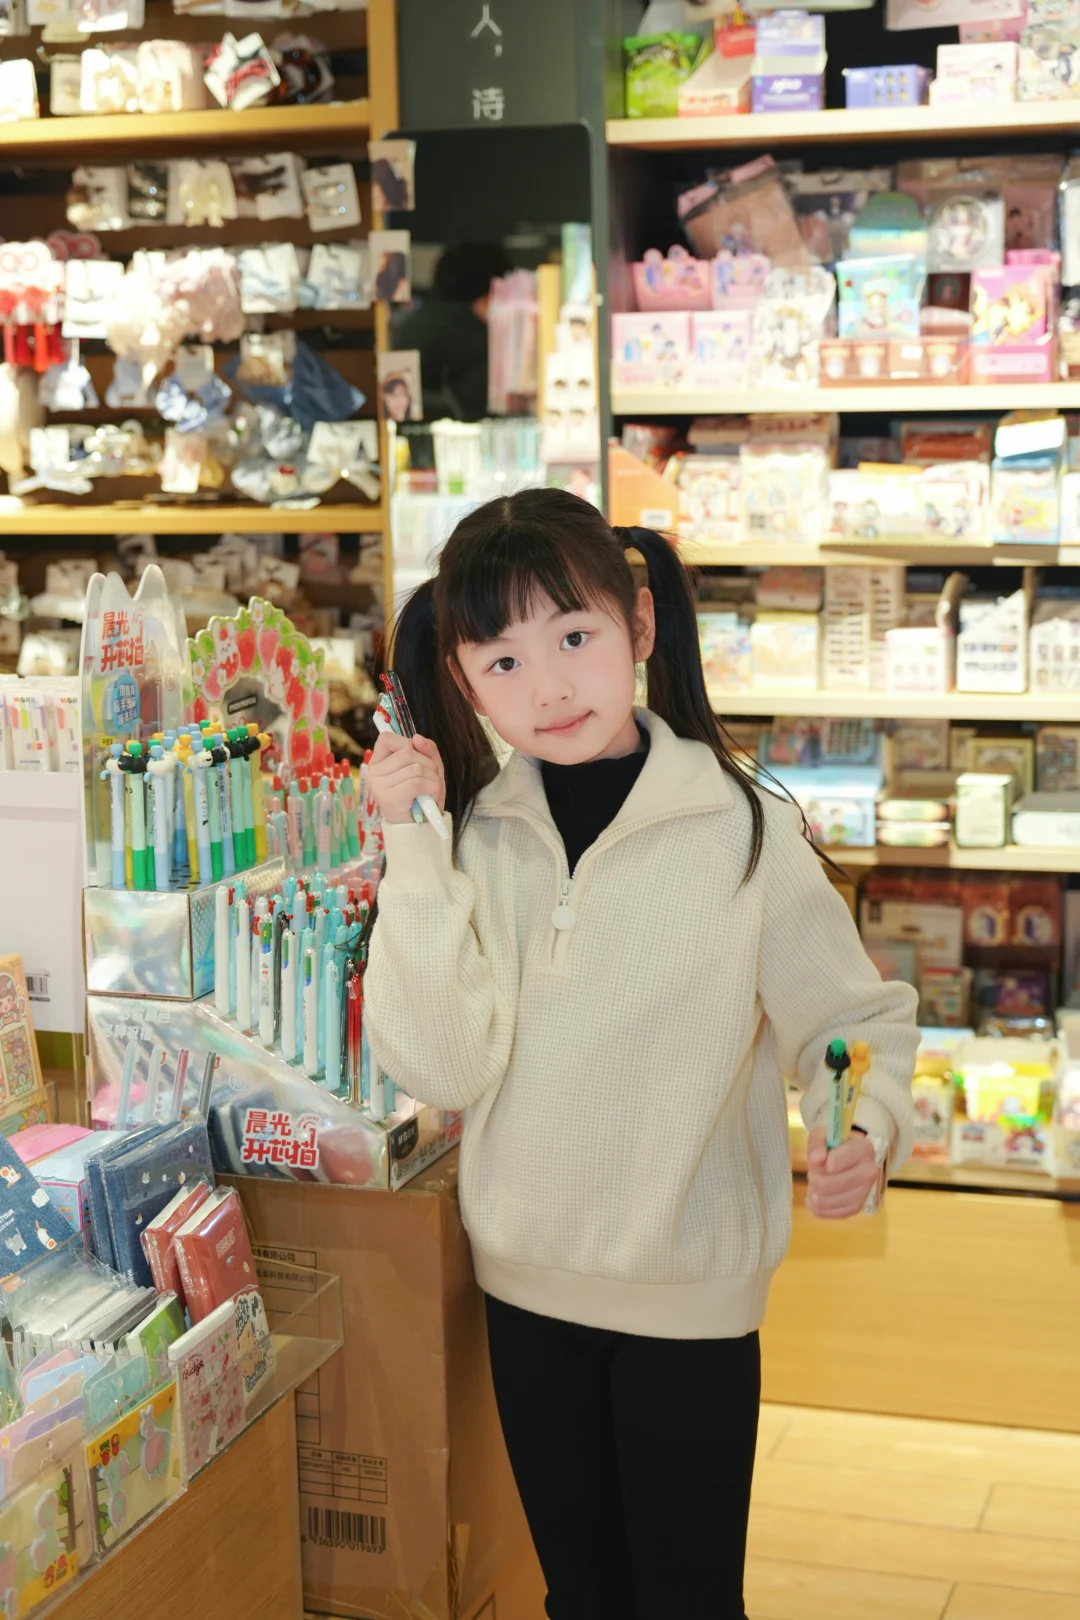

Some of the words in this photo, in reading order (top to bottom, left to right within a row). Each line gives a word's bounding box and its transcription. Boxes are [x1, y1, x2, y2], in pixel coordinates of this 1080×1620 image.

[102, 610, 130, 640] 晨光
[246, 1110, 292, 1136] 晨光
[256, 1269, 315, 1284] 科技有限公司
